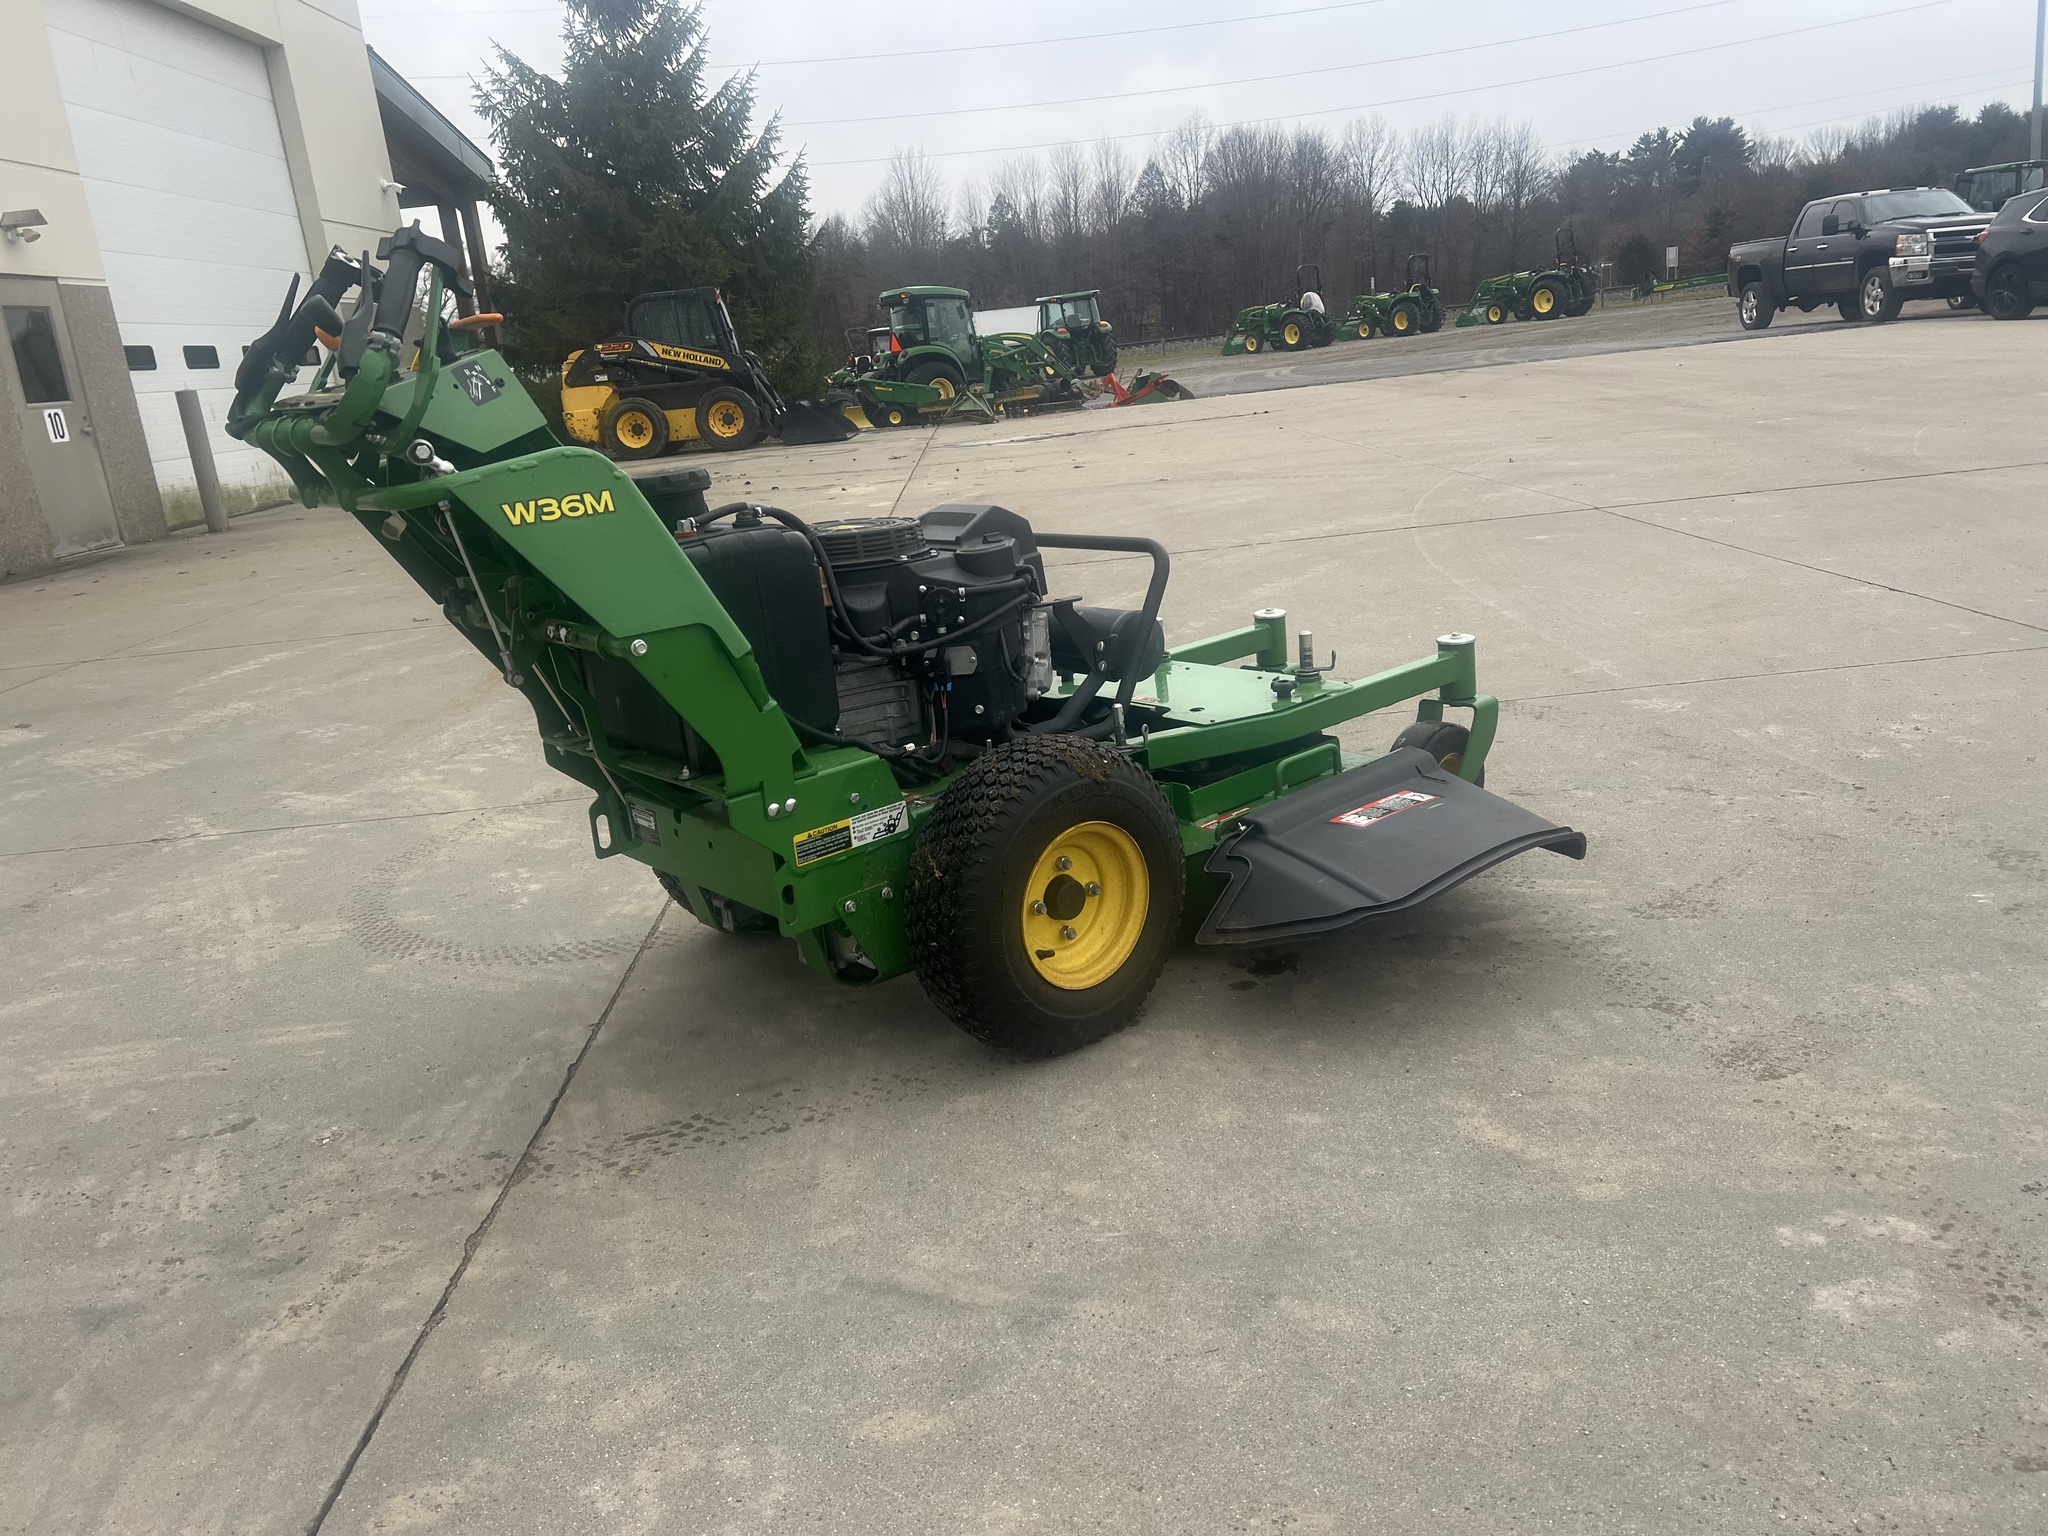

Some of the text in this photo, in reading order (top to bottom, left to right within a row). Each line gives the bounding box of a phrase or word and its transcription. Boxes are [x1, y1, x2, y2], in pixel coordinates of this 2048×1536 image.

[661, 347, 722, 366] NEW HOLLAND
[48, 412, 65, 440] 10
[500, 489, 615, 526] W36M
[812, 823, 838, 837] CAUTION
